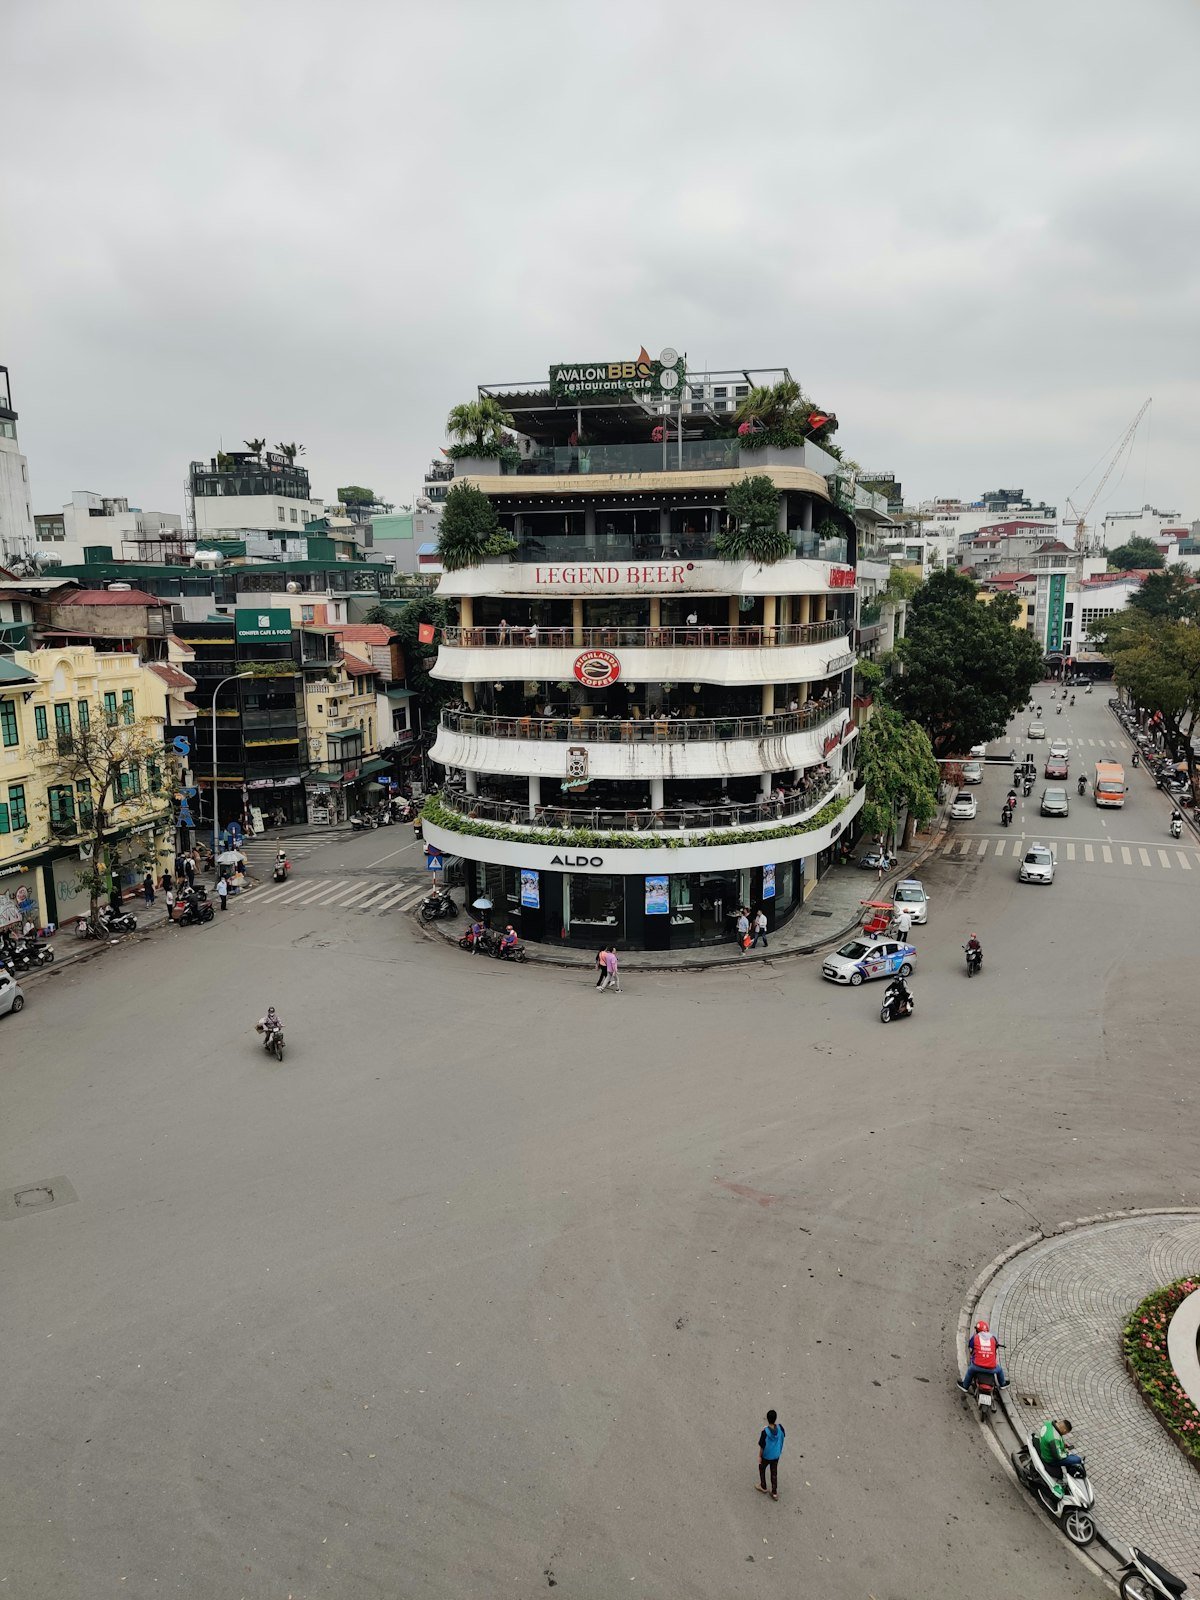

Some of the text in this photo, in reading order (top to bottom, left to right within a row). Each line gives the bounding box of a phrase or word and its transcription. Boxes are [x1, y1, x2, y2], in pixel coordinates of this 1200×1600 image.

[556, 367, 606, 381] AVALON
[535, 566, 685, 584] LEGEND BEER
[576, 652, 618, 668] HIGHLANDS
[581, 676, 614, 686] COFFEE
[550, 855, 603, 867] ALDO
